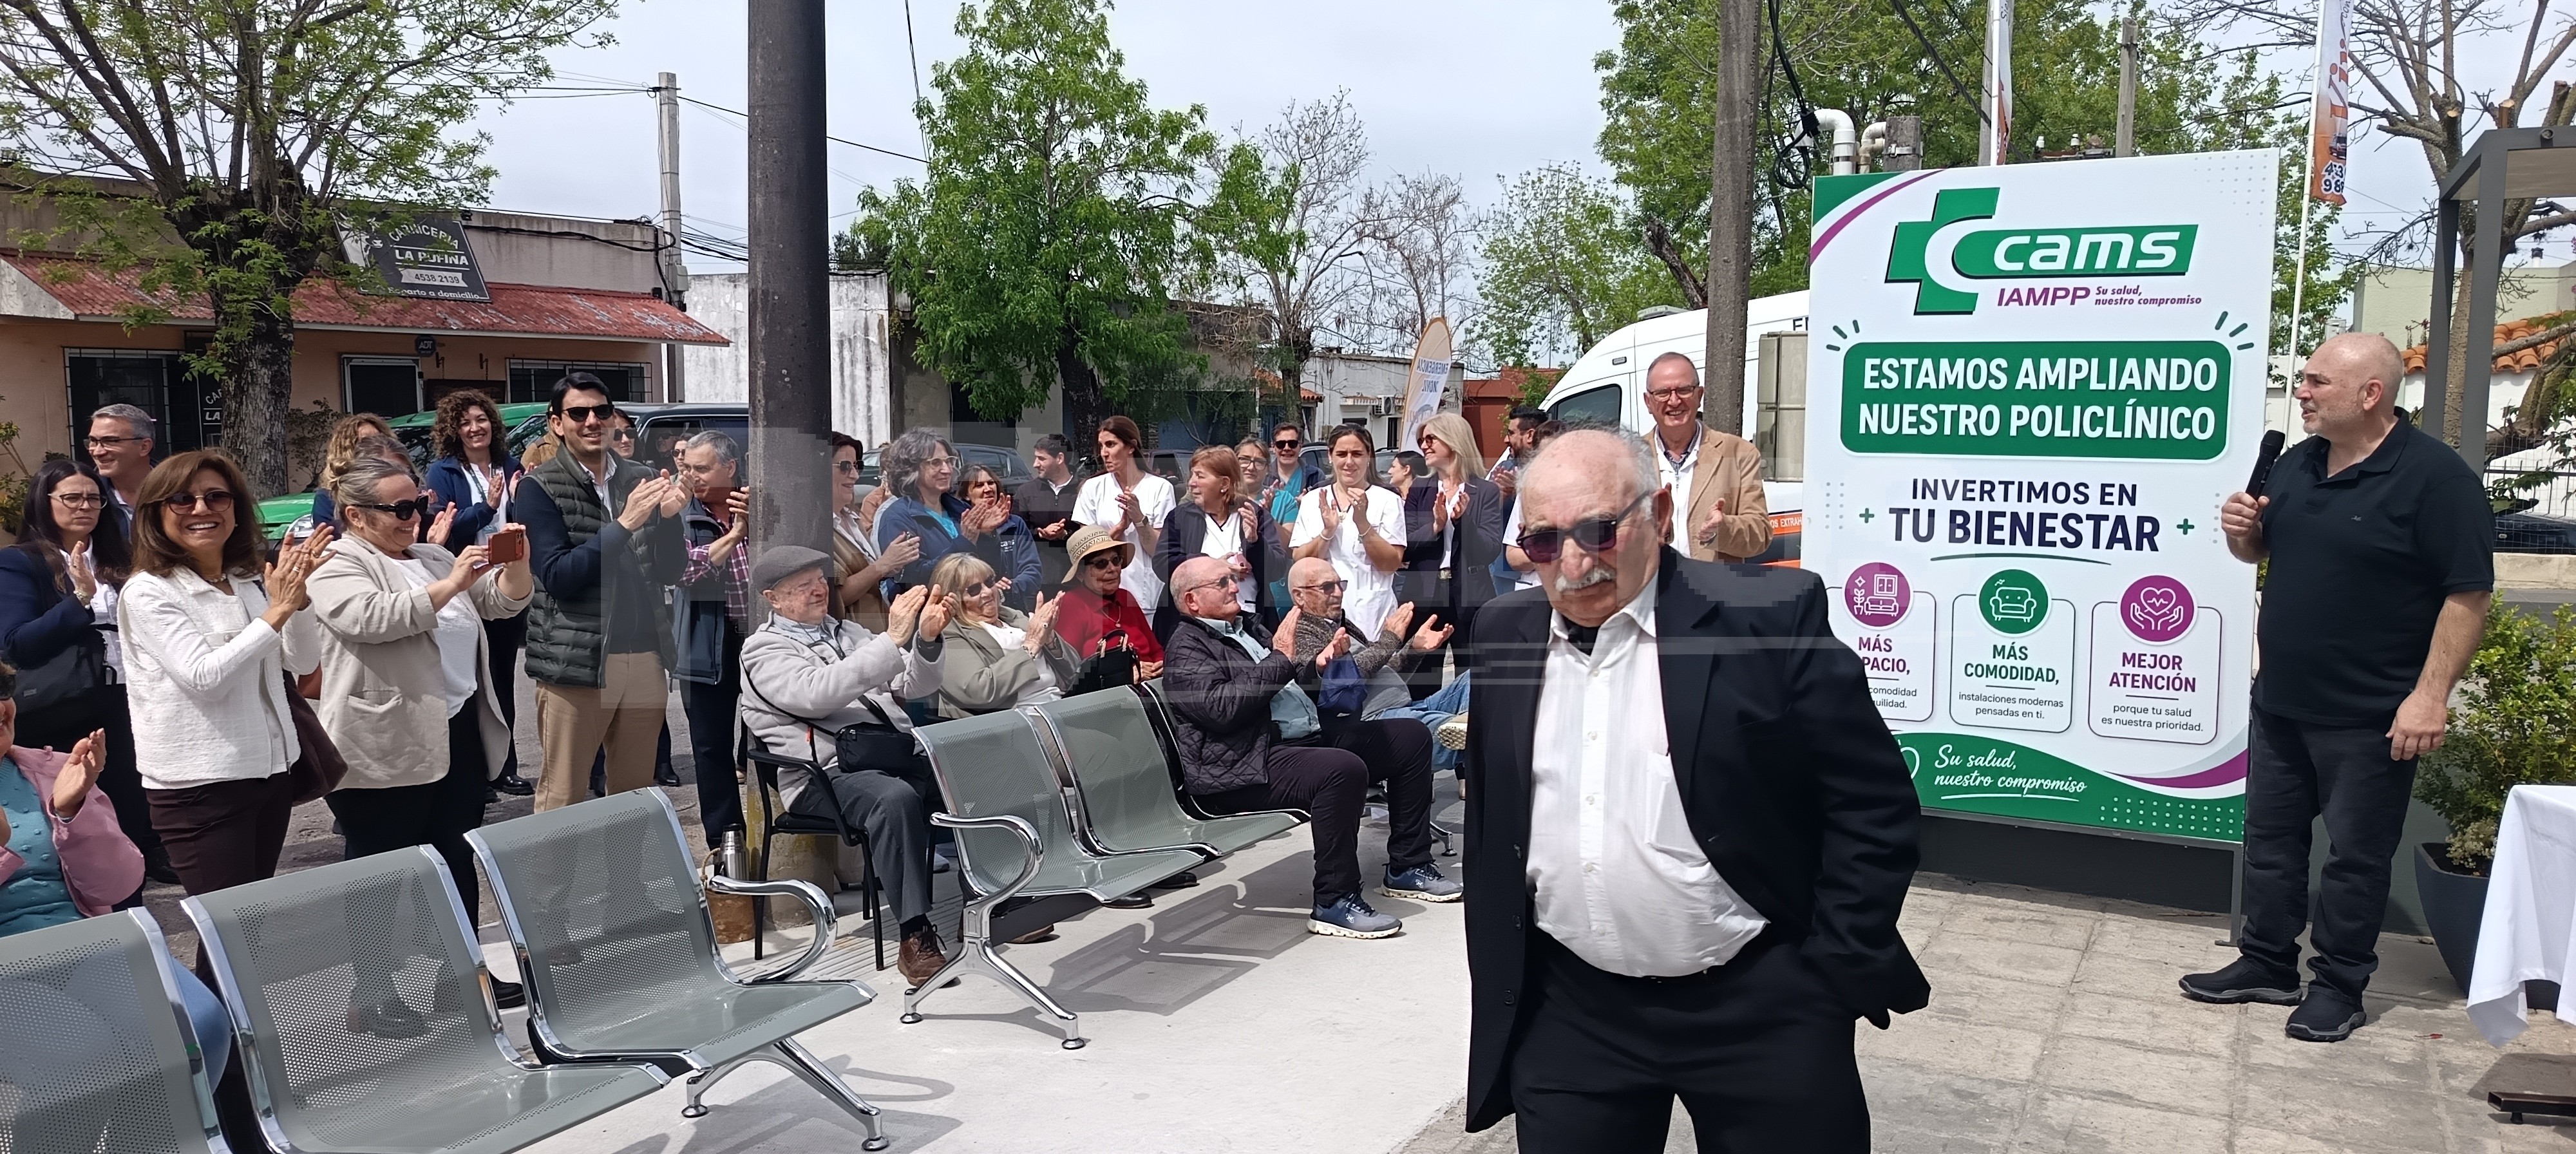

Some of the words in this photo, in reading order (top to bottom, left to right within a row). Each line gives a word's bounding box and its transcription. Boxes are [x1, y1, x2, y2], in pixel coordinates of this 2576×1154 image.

[395, 249, 414, 261] LA
[1994, 231, 2181, 271] cams
[415, 273, 437, 282] 4538
[438, 275, 460, 284] 2139
[438, 290, 480, 299] domicilio
[1997, 287, 2091, 307] IAMPP
[2096, 286, 2108, 296] Su
[2111, 285, 2143, 296] salud,
[2095, 296, 2134, 306] nuestro
[2137, 294, 2202, 307] compromiso
[419, 341, 433, 349] ADT
[1863, 357, 2008, 390] ESTAMOS
[2015, 357, 2218, 392] AMPLIANDO
[205, 411, 221, 421] LA
[1859, 402, 2000, 436] NUESTRO
[2009, 398, 2216, 440] POLICLÍNICO
[1912, 478, 2090, 506] INVERTIMOS
[2099, 483, 2137, 507] EN
[1889, 507, 1936, 543] TU
[1948, 509, 2161, 553] BIENESTAR
[1859, 634, 1893, 652] MÁS
[1993, 641, 2028, 661] MÁS
[1862, 656, 1911, 676] PACIO,
[2121, 652, 2183, 671] MEJOR
[1964, 663, 2060, 685] COMODIDAD,
[2109, 672, 2196, 693] ATENCIÓN
[1873, 699, 1908, 708] uilidad.
[1958, 692, 2016, 704] instalaciones
[2018, 697, 2064, 708] modernas
[1976, 708, 2020, 717] pensadas
[2036, 710, 2045, 719] ti.
[2113, 705, 2149, 715] porque
[2152, 706, 2162, 715] tu
[2164, 708, 2192, 717] salud
[2115, 717, 2152, 728] nuestra
[2155, 720, 2204, 732] prioridad.
[1935, 744, 1963, 769] Su
[1966, 748, 2016, 770] salud,
[1934, 770, 1994, 787] nuestro
[1997, 776, 2088, 795] compromiso
